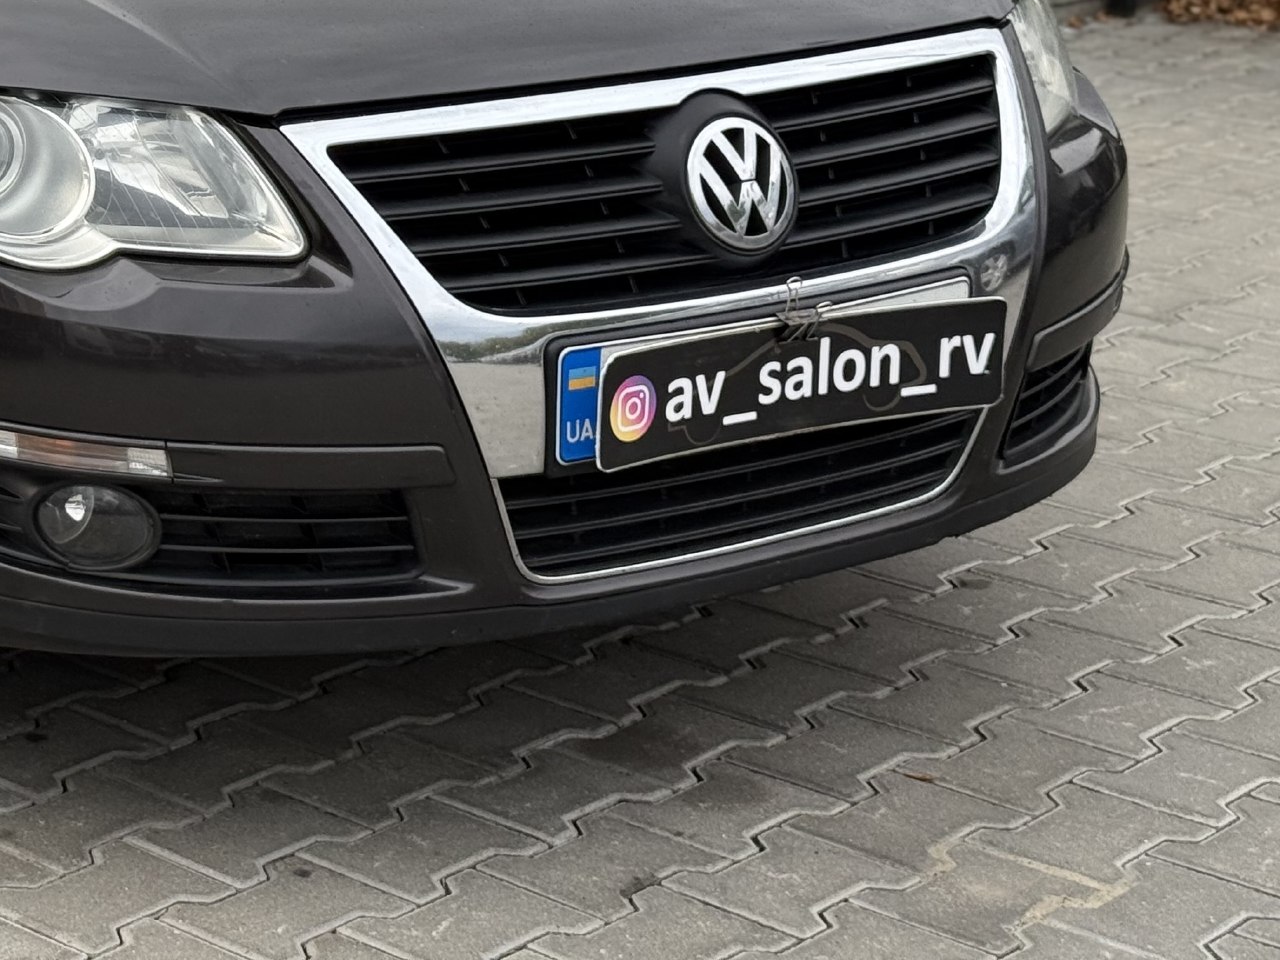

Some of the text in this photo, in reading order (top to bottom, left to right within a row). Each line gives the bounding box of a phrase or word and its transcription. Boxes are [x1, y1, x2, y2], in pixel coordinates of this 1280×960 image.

[688, 118, 794, 248] VW
[665, 332, 996, 427] av_salon_rv
[566, 418, 594, 444] UA
